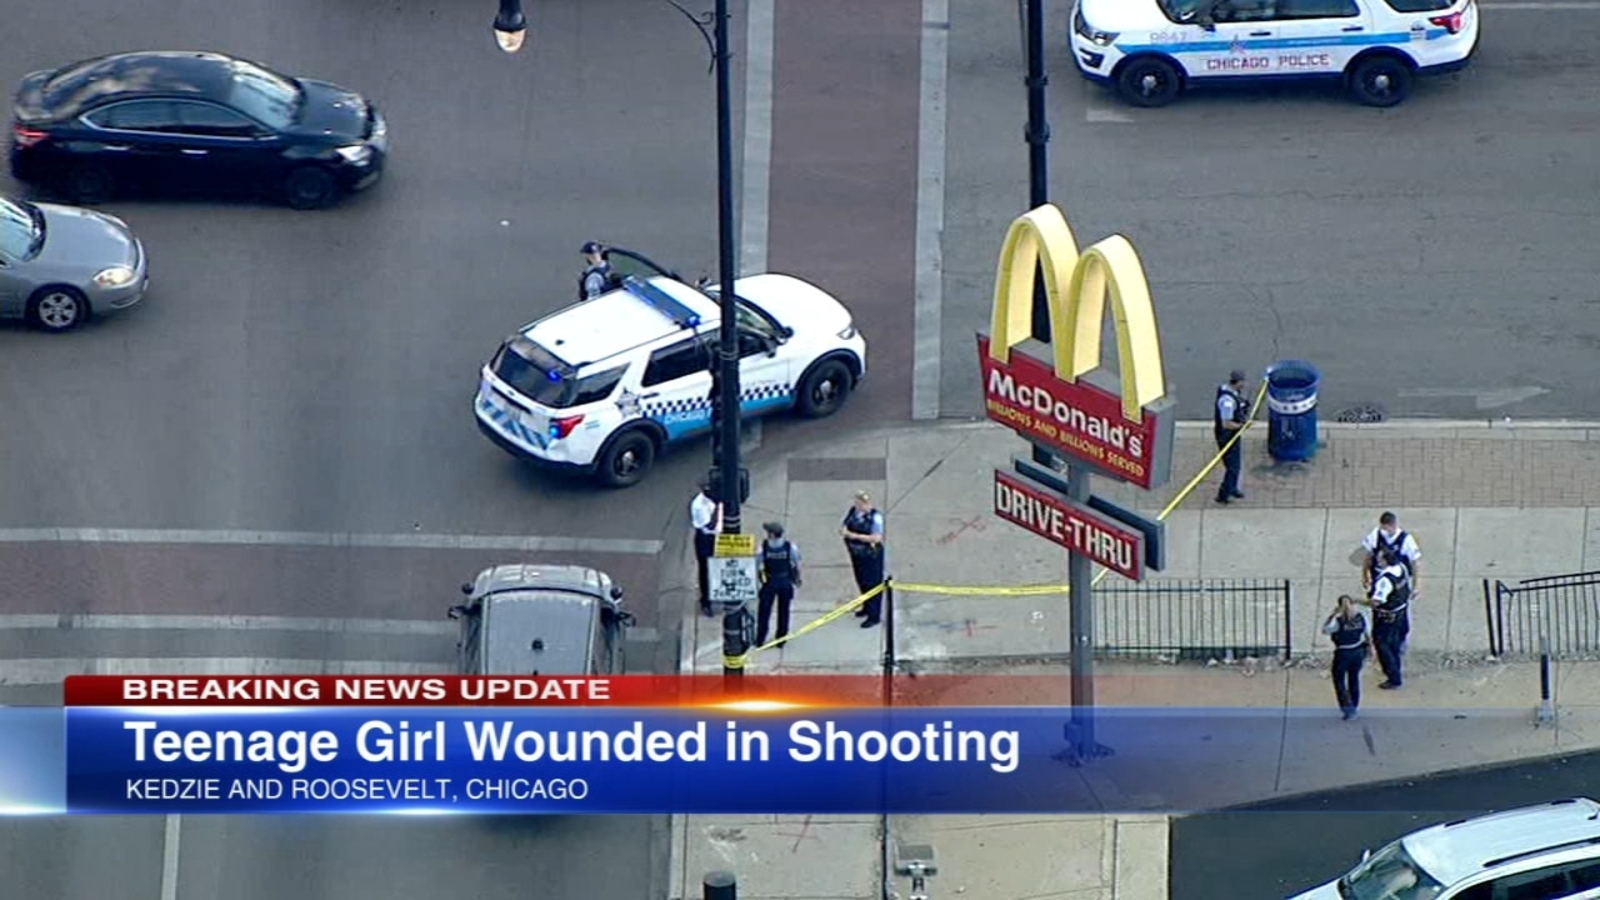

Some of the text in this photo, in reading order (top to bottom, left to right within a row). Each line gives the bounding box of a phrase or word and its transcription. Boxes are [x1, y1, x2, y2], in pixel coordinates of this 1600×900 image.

[1206, 53, 1330, 71] CHICAGO POLICE
[988, 368, 1144, 460] McDonald's
[1034, 418, 1058, 437] AND
[1059, 429, 1105, 460] BILLIONS
[1107, 450, 1145, 478] SERVED
[996, 481, 1132, 571] DRIVE-THRU
